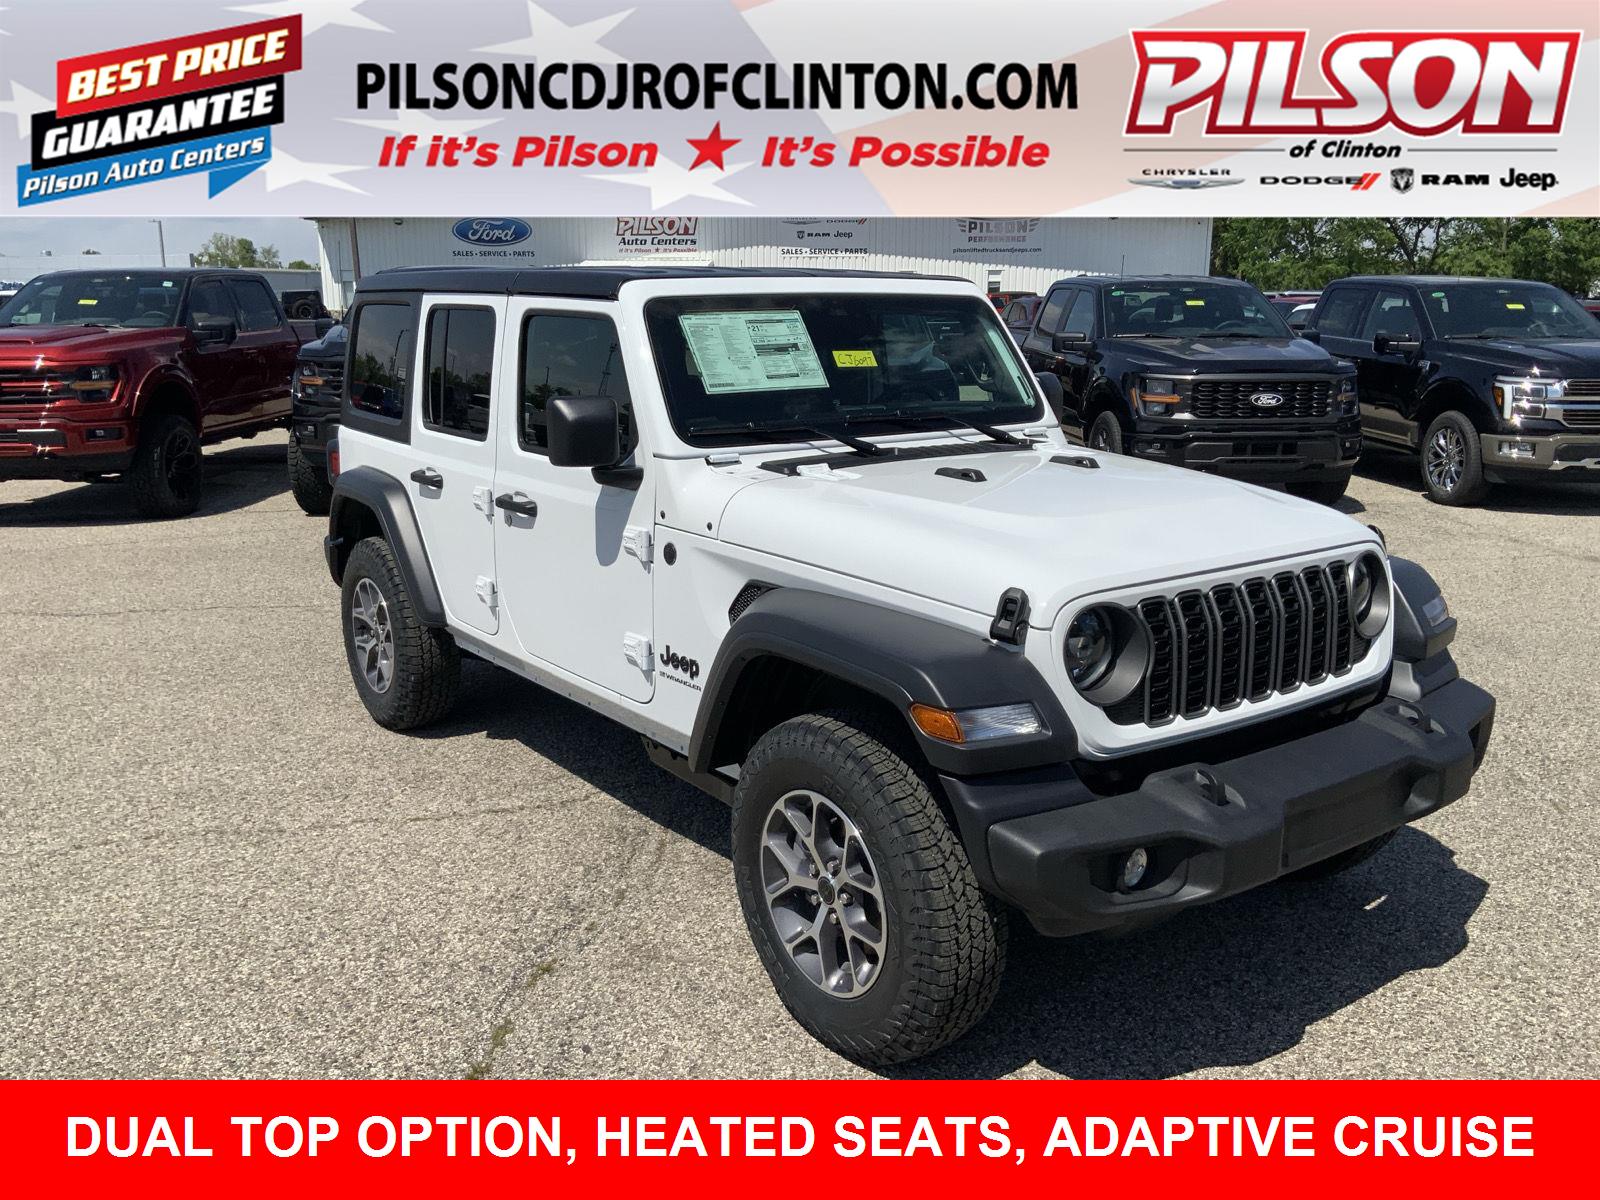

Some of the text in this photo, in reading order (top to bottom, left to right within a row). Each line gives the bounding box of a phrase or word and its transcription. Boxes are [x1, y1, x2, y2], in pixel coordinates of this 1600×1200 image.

[468, 219, 516, 241] Ford
[617, 216, 697, 236] PILSON
[968, 220, 1028, 233] PILSON
[619, 237, 697, 246] Auto Centers
[513, 250, 535, 258] PARTS
[660, 644, 700, 681] Jeep
[665, 672, 702, 692] WRANGLER
